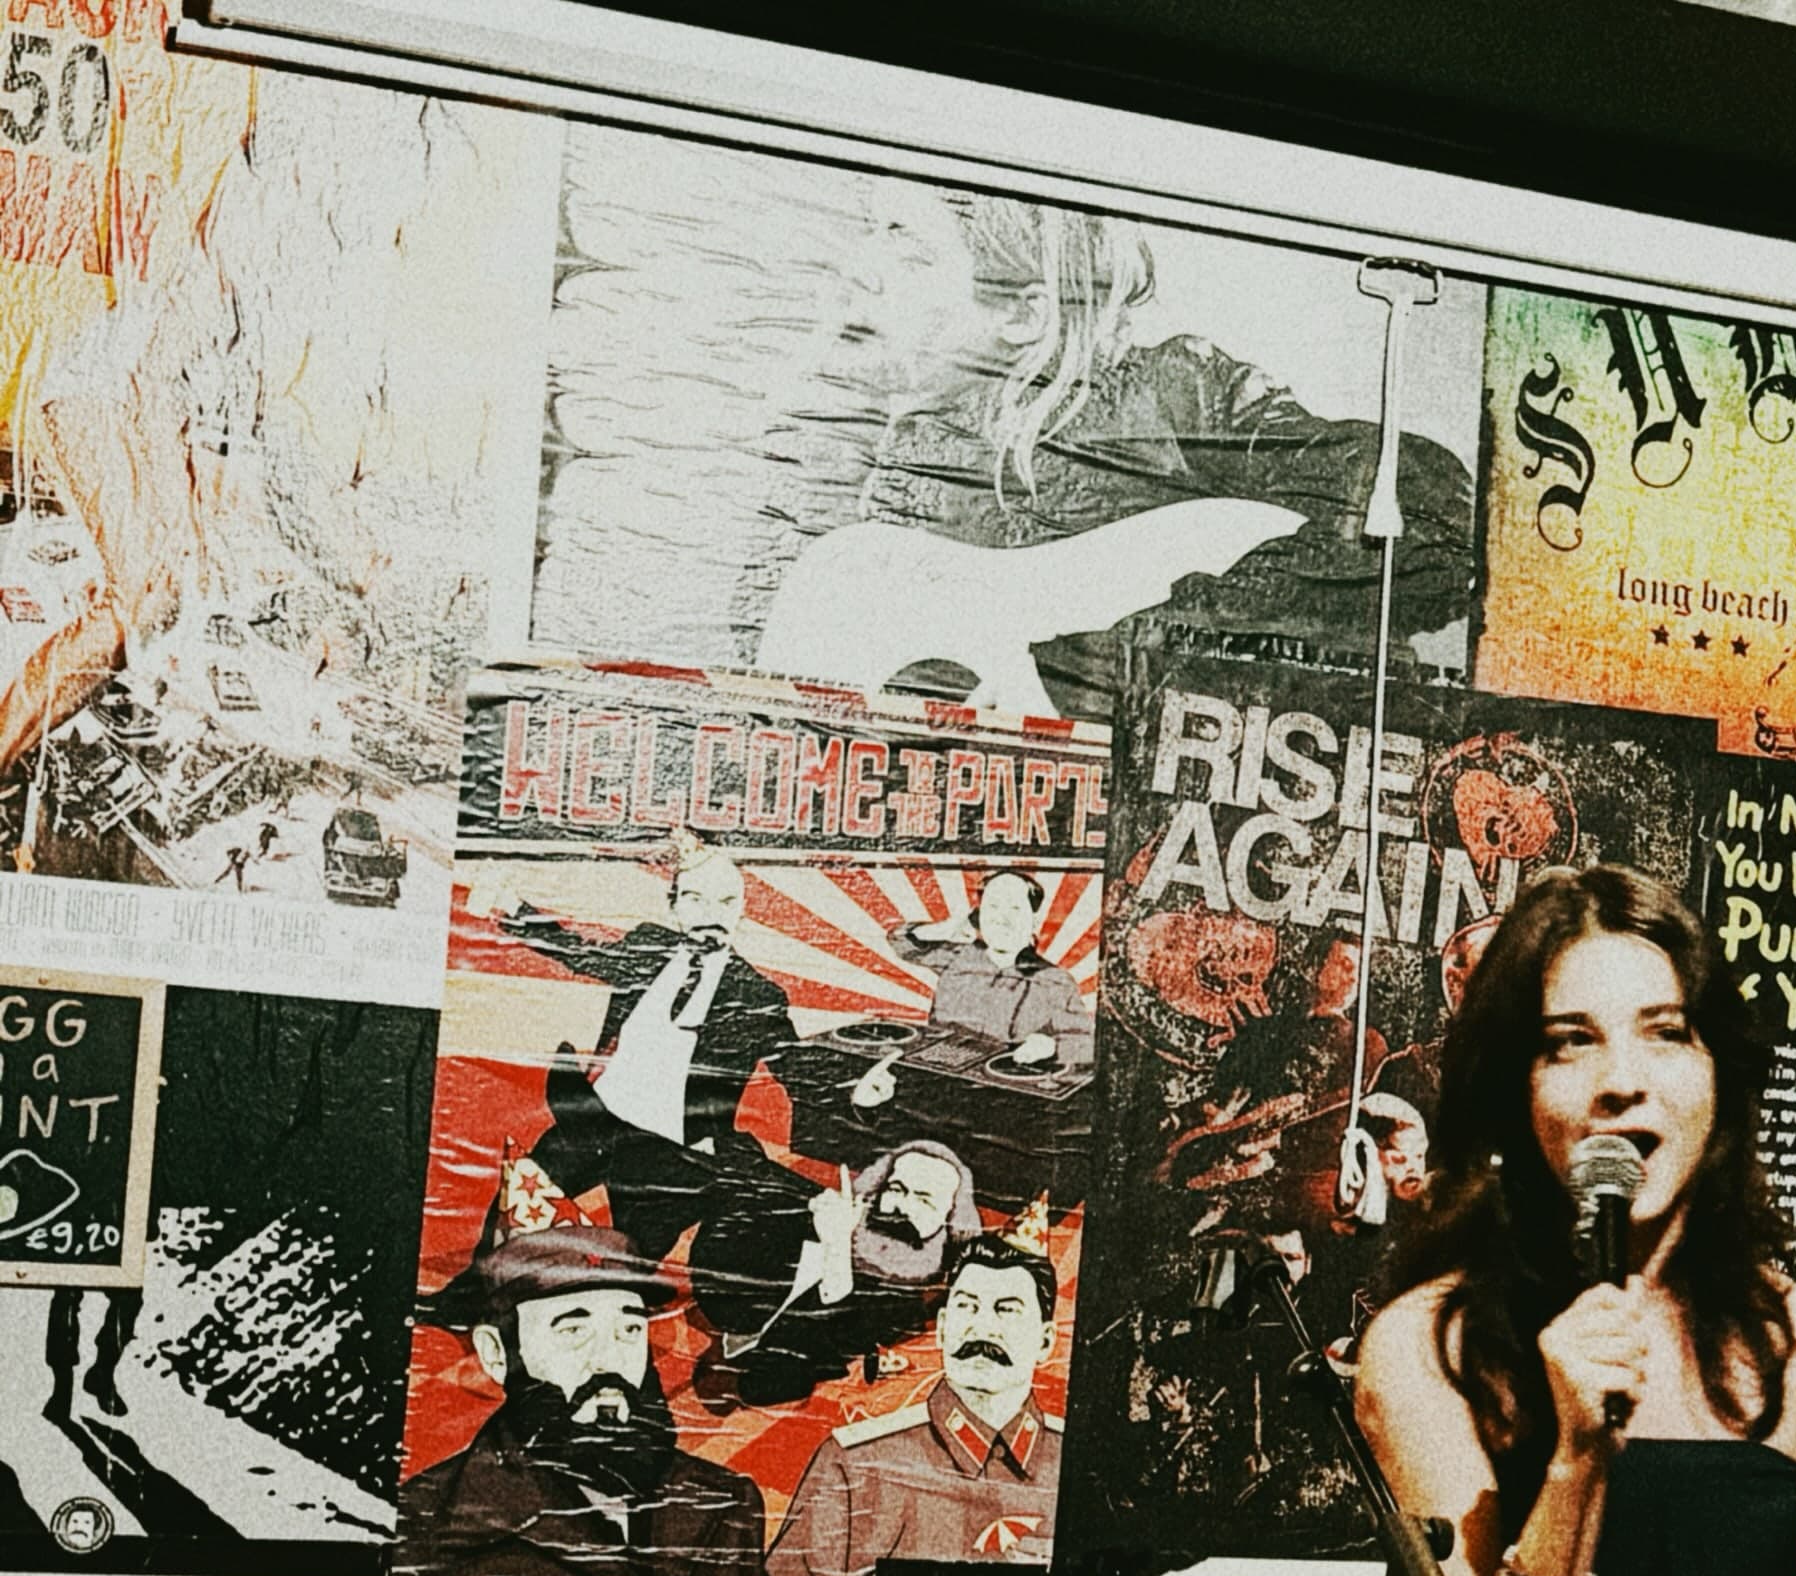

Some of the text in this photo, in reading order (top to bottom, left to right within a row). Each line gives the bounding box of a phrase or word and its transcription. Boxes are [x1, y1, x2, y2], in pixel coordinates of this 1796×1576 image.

[0, 32, 110, 154] 50
[1616, 567, 1691, 619] long
[501, 700, 889, 838] WELCOME
[1151, 689, 1425, 839] RISE
[1727, 790, 1763, 832] In
[1137, 800, 1520, 949] AGAIN
[1715, 842, 1782, 892] You
[0, 995, 87, 1048] GG
[33, 1053, 60, 1083] a
